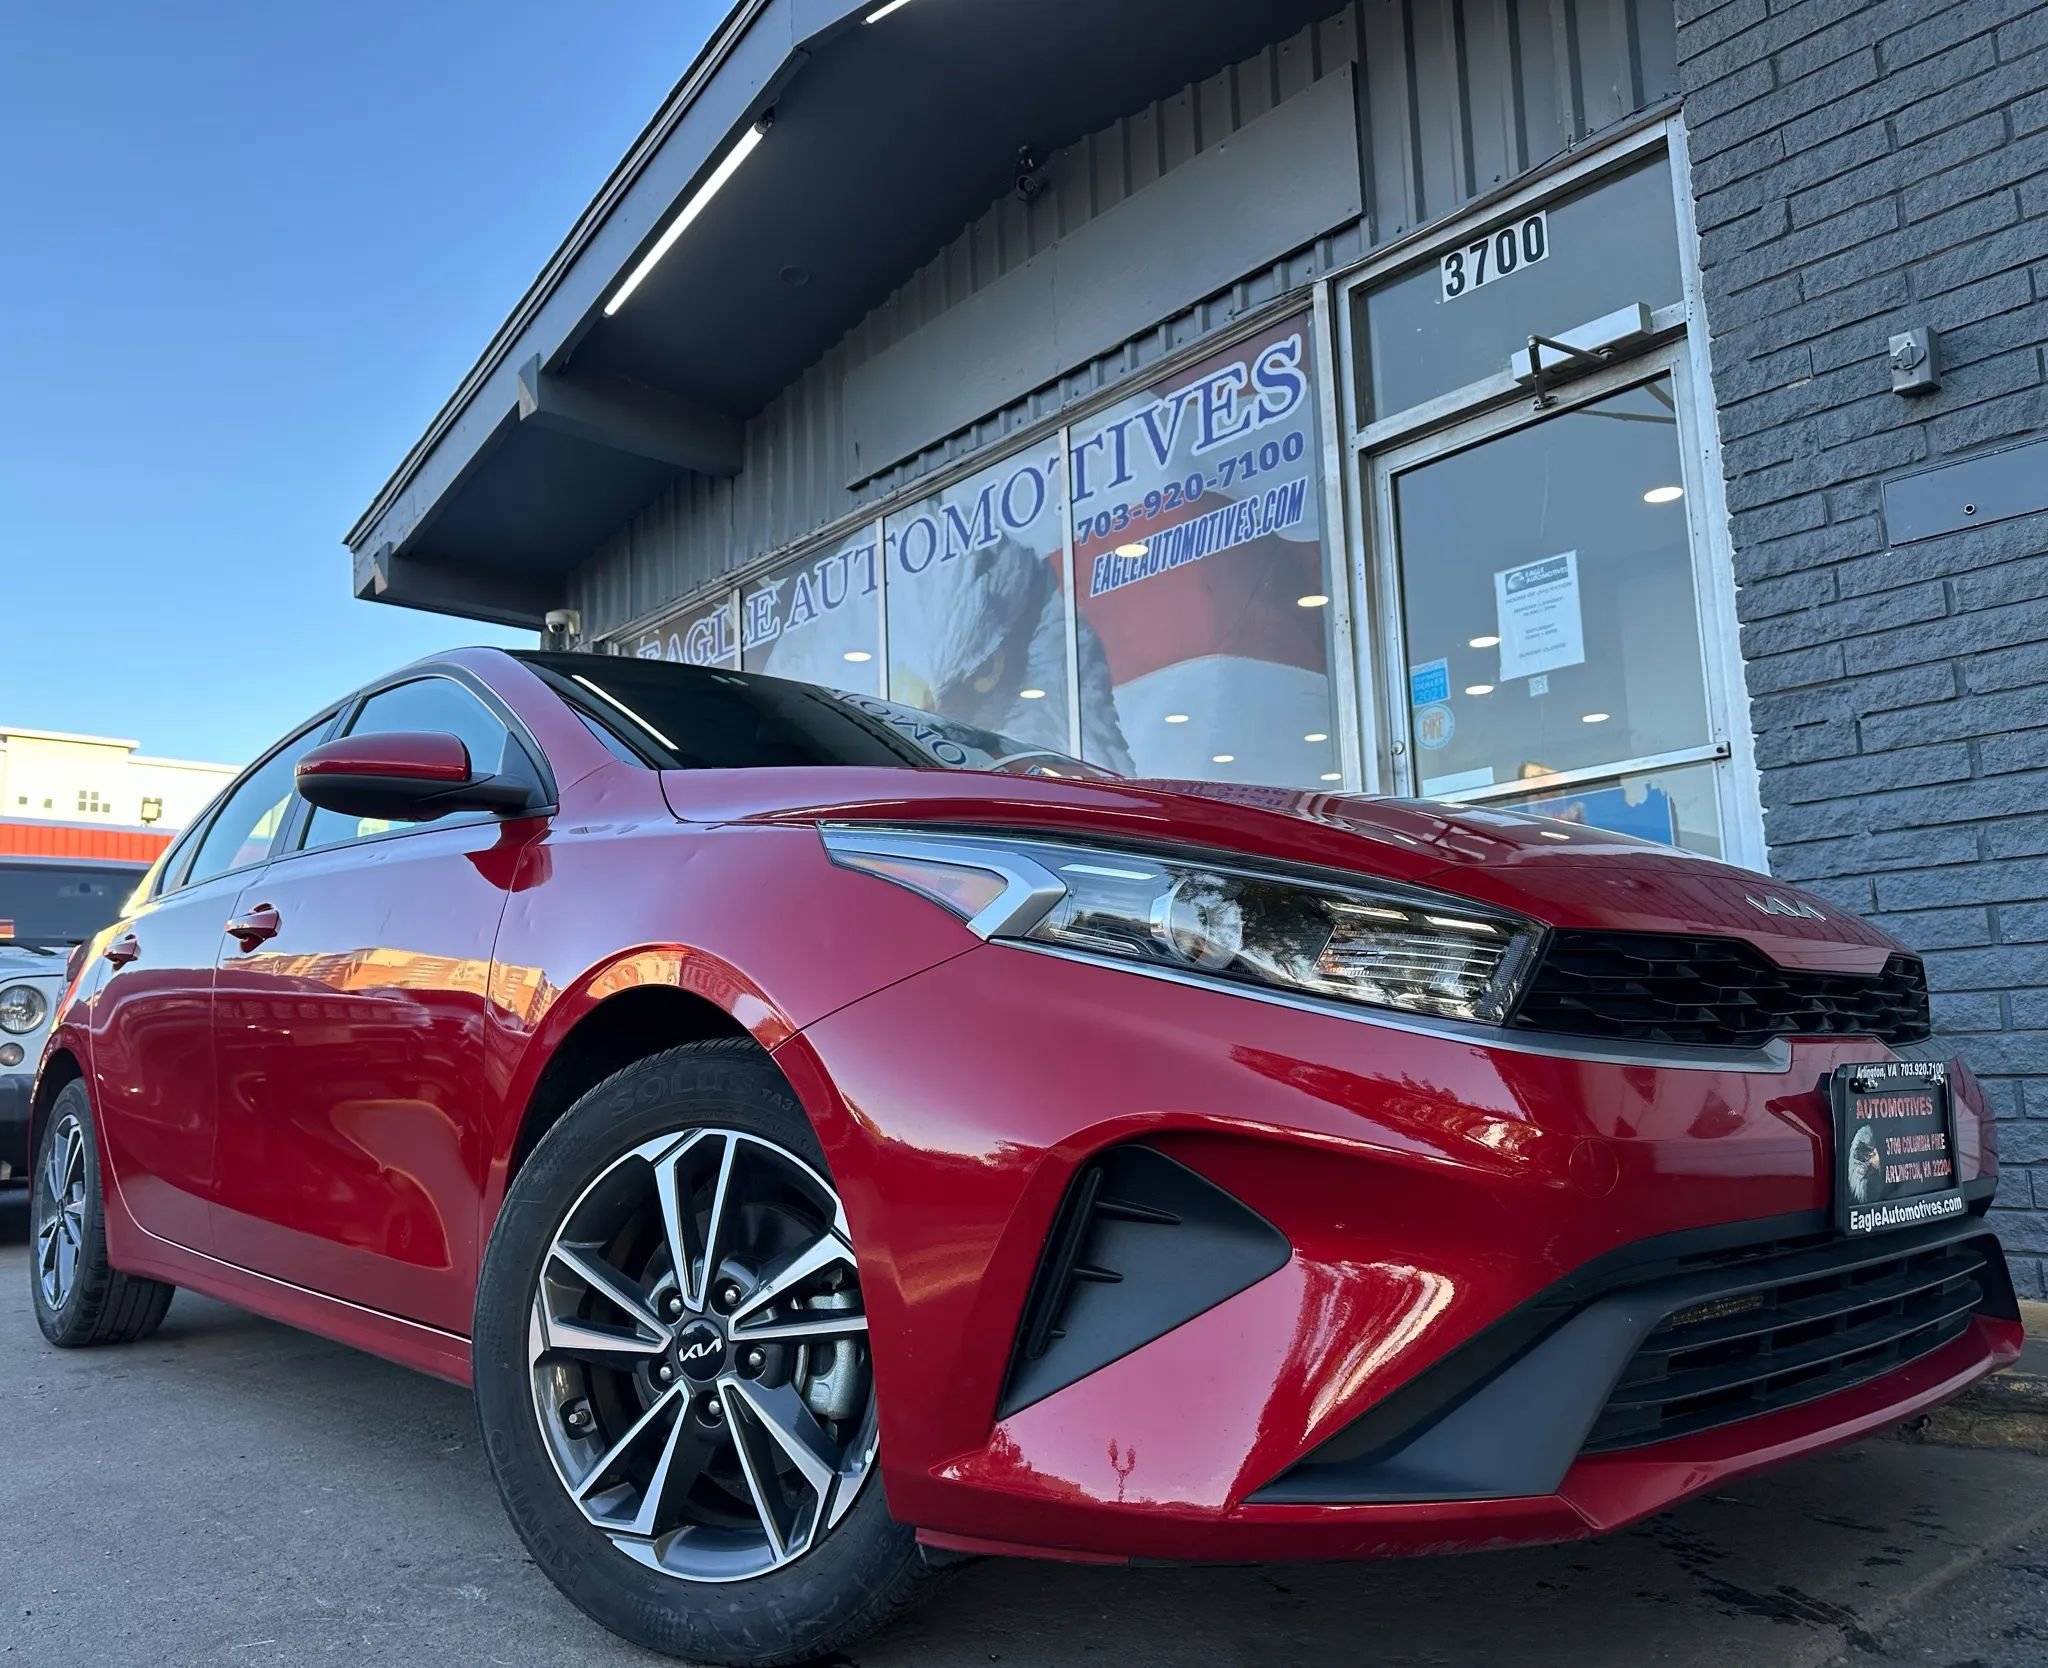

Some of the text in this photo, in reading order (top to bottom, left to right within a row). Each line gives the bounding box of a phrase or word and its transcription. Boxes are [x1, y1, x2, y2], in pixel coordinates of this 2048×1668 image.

[1444, 215, 1545, 297] 3700
[784, 333, 1306, 632] AUTOMOTIVES
[1077, 432, 1304, 545] 703-920-7100
[1090, 475, 1308, 598] EAGLEAUTOMOTIVES.COM
[1416, 686, 1446, 704] 2021
[1856, 1062, 1945, 1081] Arlington, VA 703.920.7100
[1856, 1096, 1933, 1119] AUTOMOTIVES
[1885, 1163, 1924, 1184] ARLINGTON,
[1850, 1195, 1963, 1232] EagleAutomotives.com
[678, 1337, 723, 1362] KIA
